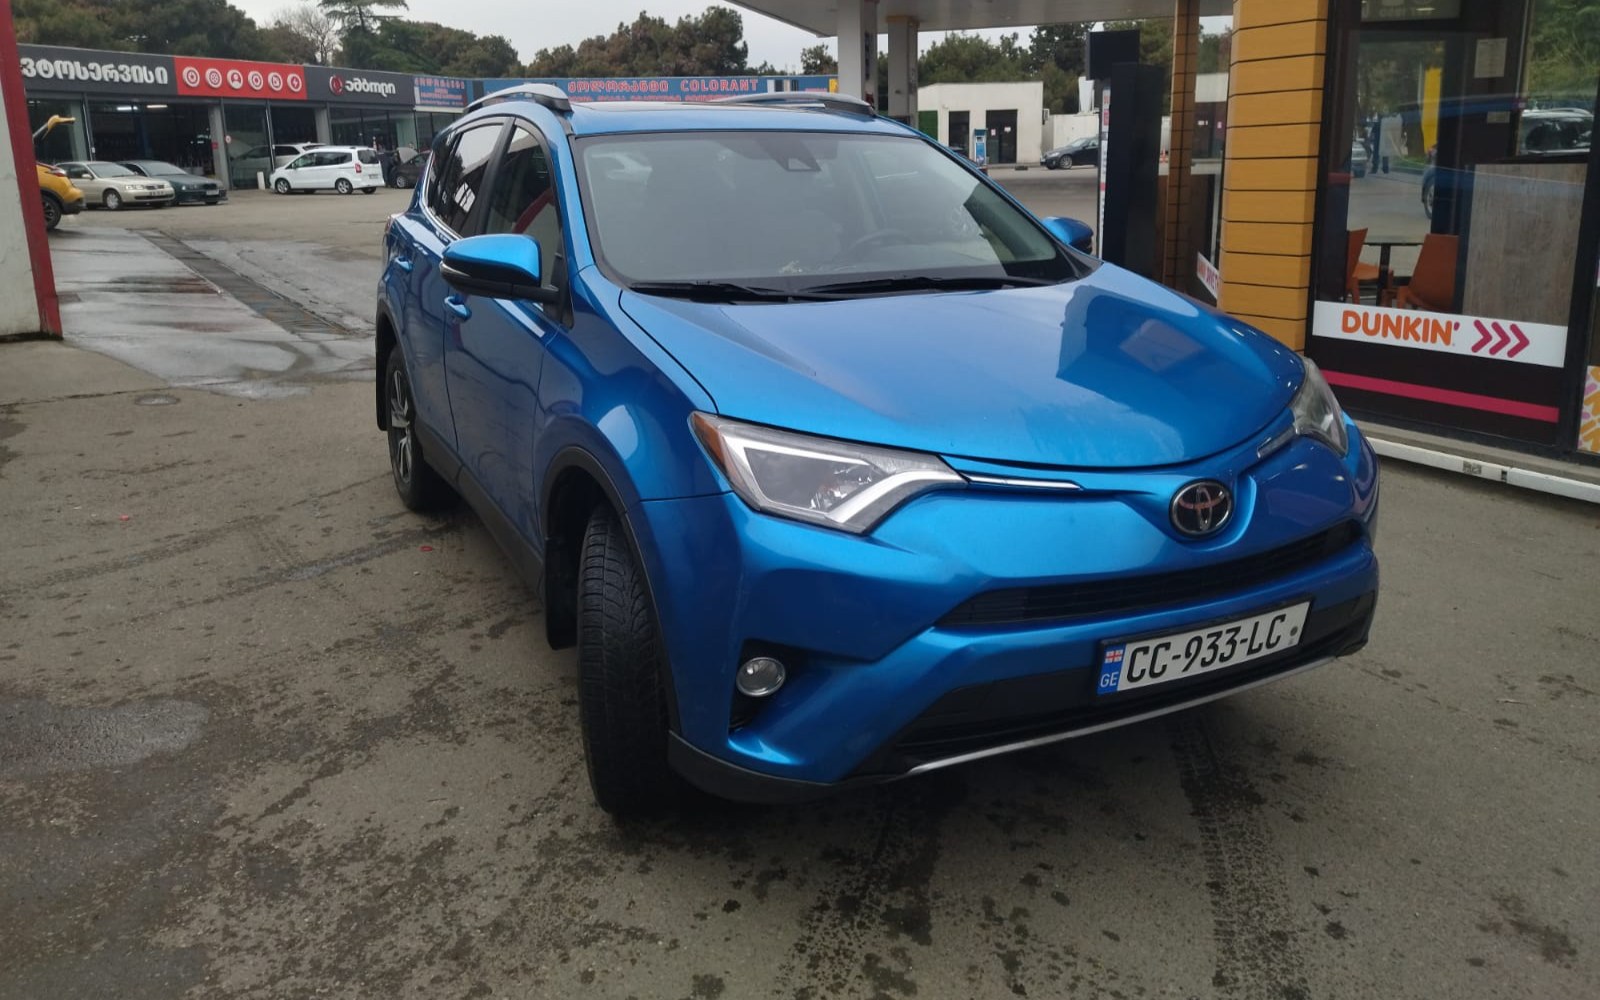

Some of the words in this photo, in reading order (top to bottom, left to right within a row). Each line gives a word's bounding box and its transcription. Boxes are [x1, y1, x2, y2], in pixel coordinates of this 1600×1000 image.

[20, 57, 168, 84] ვტოსერვისი
[680, 79, 759, 92] COLORANT
[1341, 310, 1460, 346] DUNKIN'
[1126, 613, 1286, 683] CC-933-LC
[1100, 671, 1119, 688] GE
